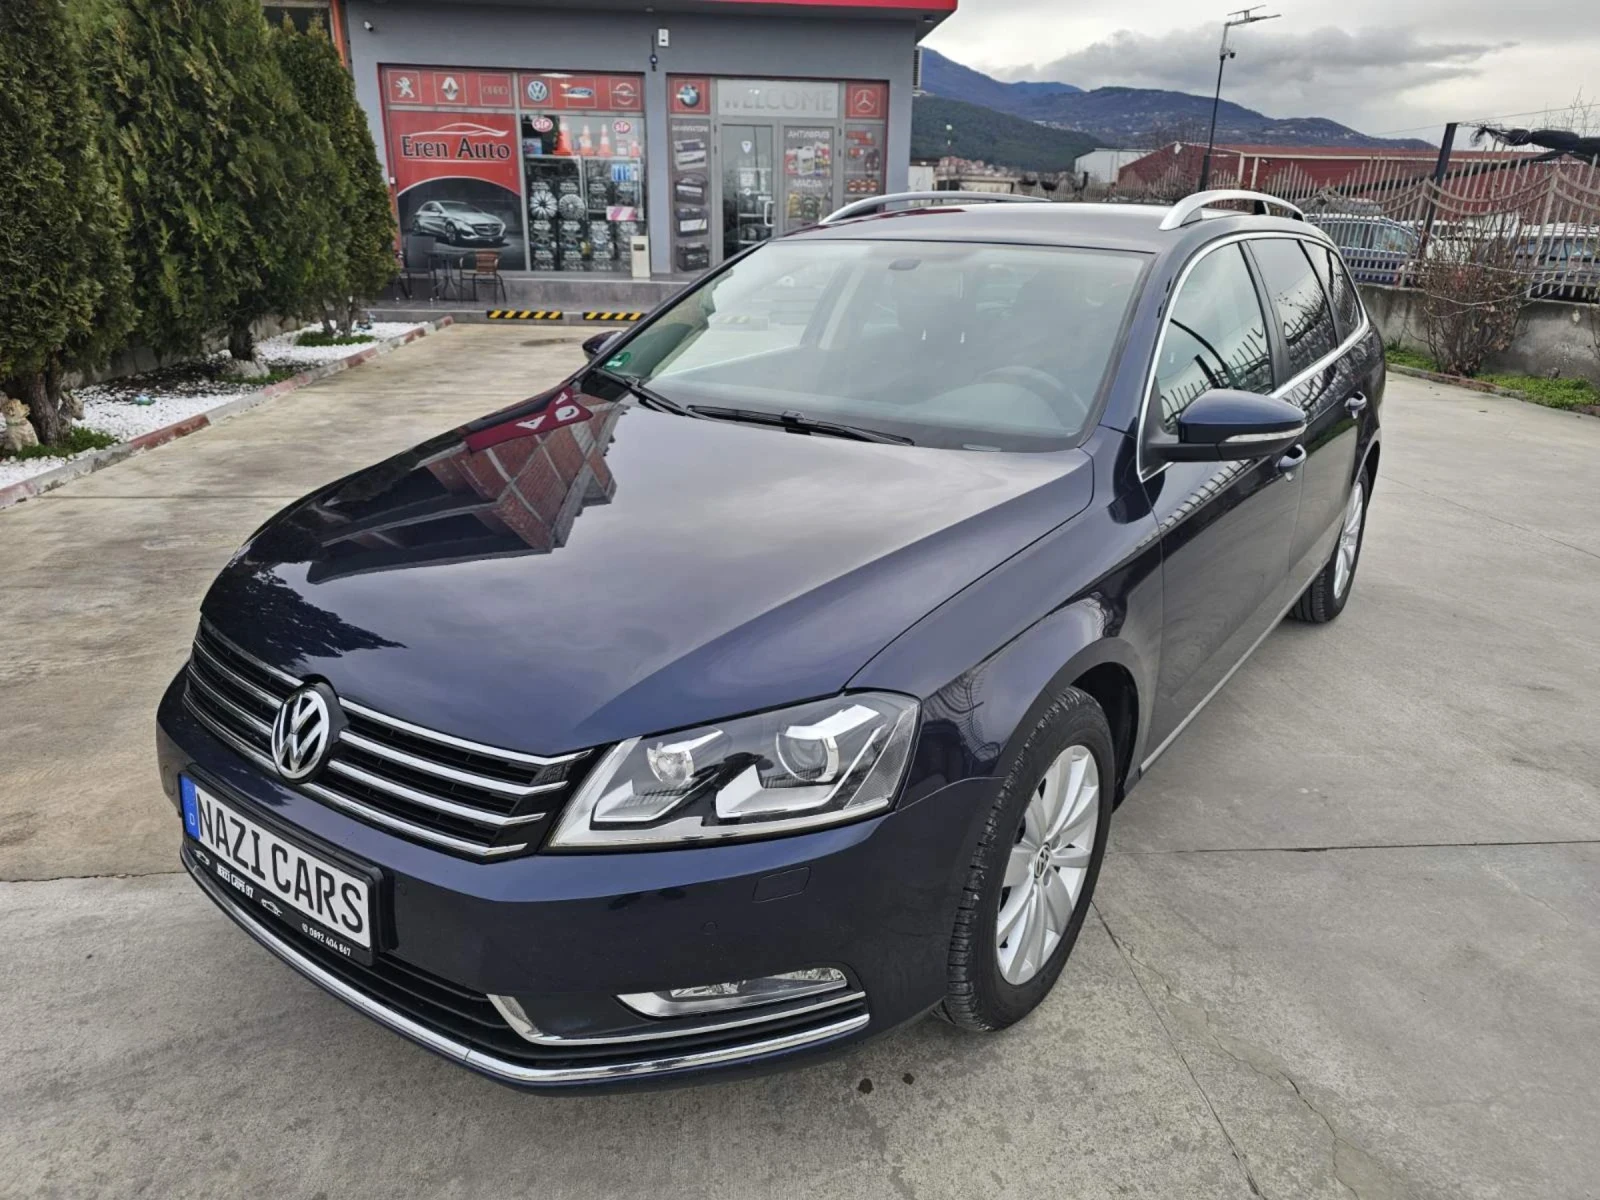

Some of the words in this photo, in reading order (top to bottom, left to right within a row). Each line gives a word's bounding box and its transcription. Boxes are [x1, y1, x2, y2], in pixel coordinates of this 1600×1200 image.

[723, 89, 833, 112] WELCOME
[401, 136, 448, 157] Eren
[457, 138, 510, 159] Auto
[189, 813, 195, 826] D
[197, 793, 266, 881] NAZI
[271, 843, 363, 934] CARS
